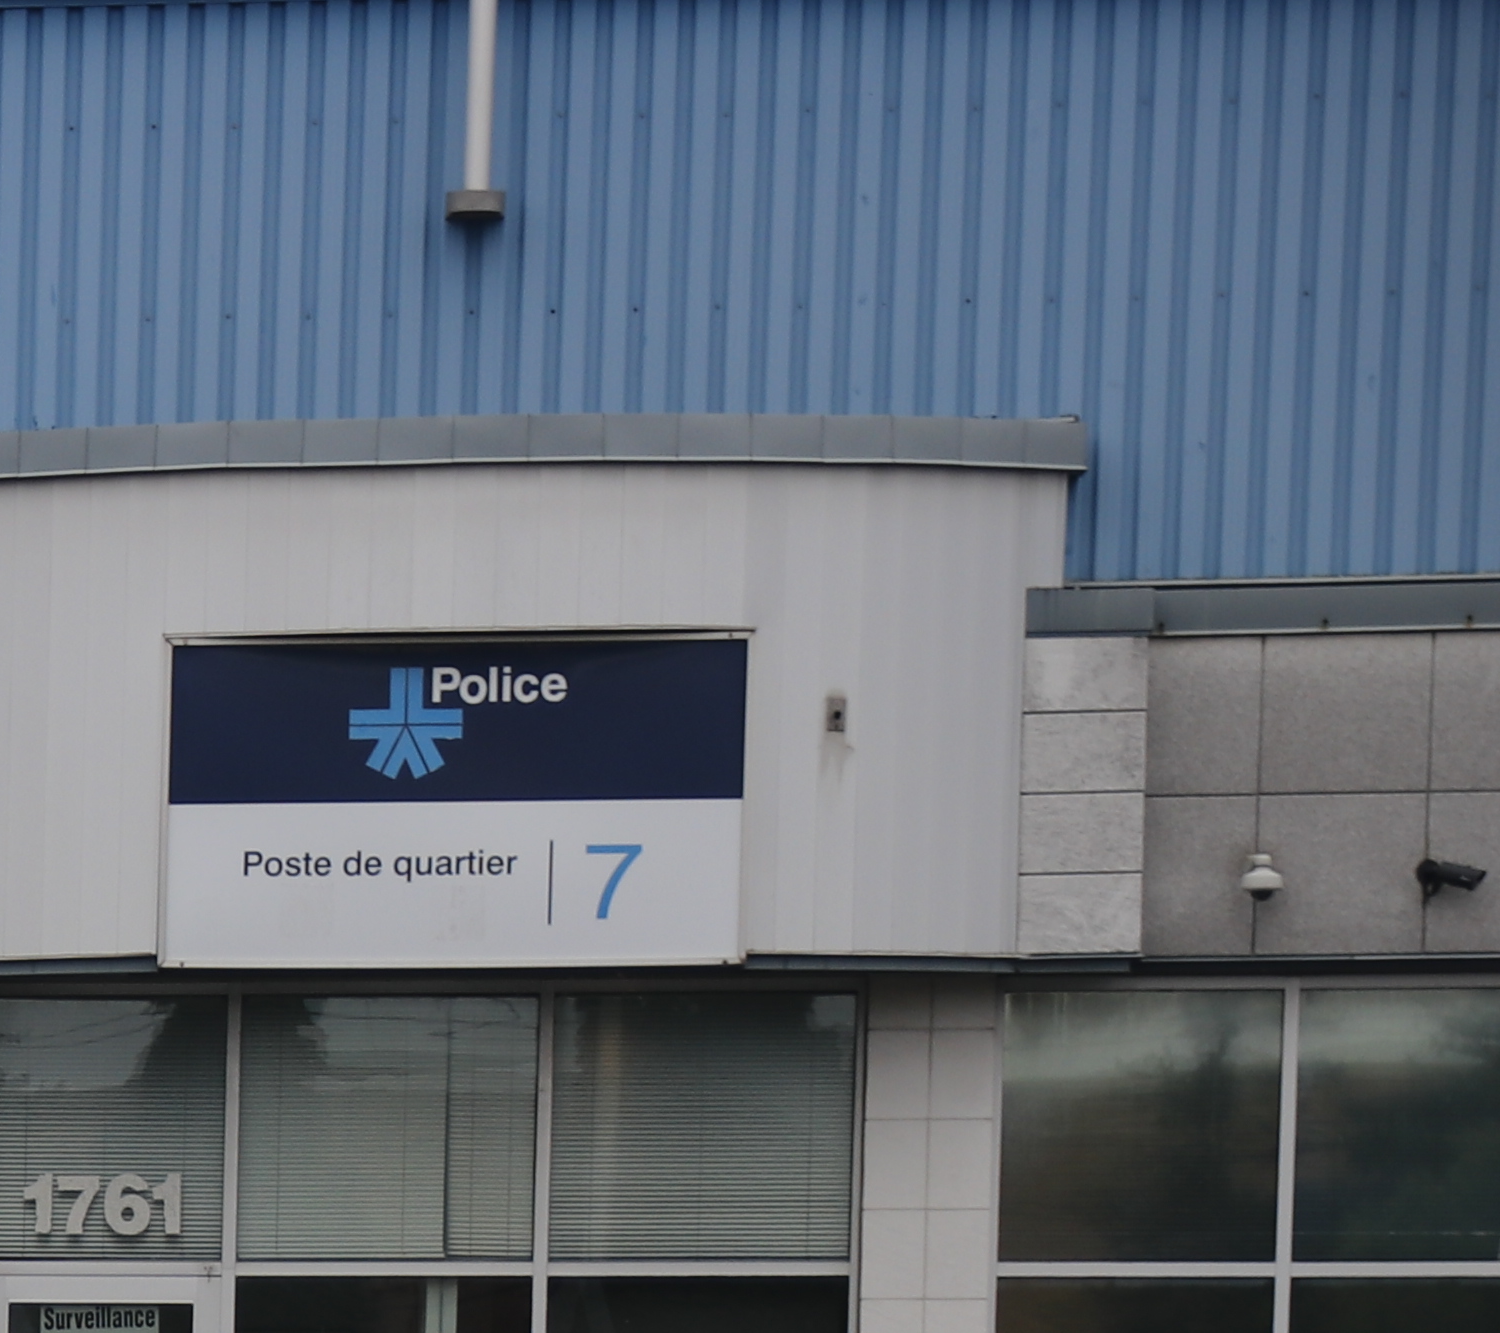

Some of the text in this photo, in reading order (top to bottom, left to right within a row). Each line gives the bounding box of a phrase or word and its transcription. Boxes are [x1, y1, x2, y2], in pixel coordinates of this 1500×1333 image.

[431, 666, 569, 704] Police
[242, 843, 644, 920] Poste de quartier 7
[23, 1172, 182, 1236] 1761
[43, 1306, 156, 1331] Surveillance
